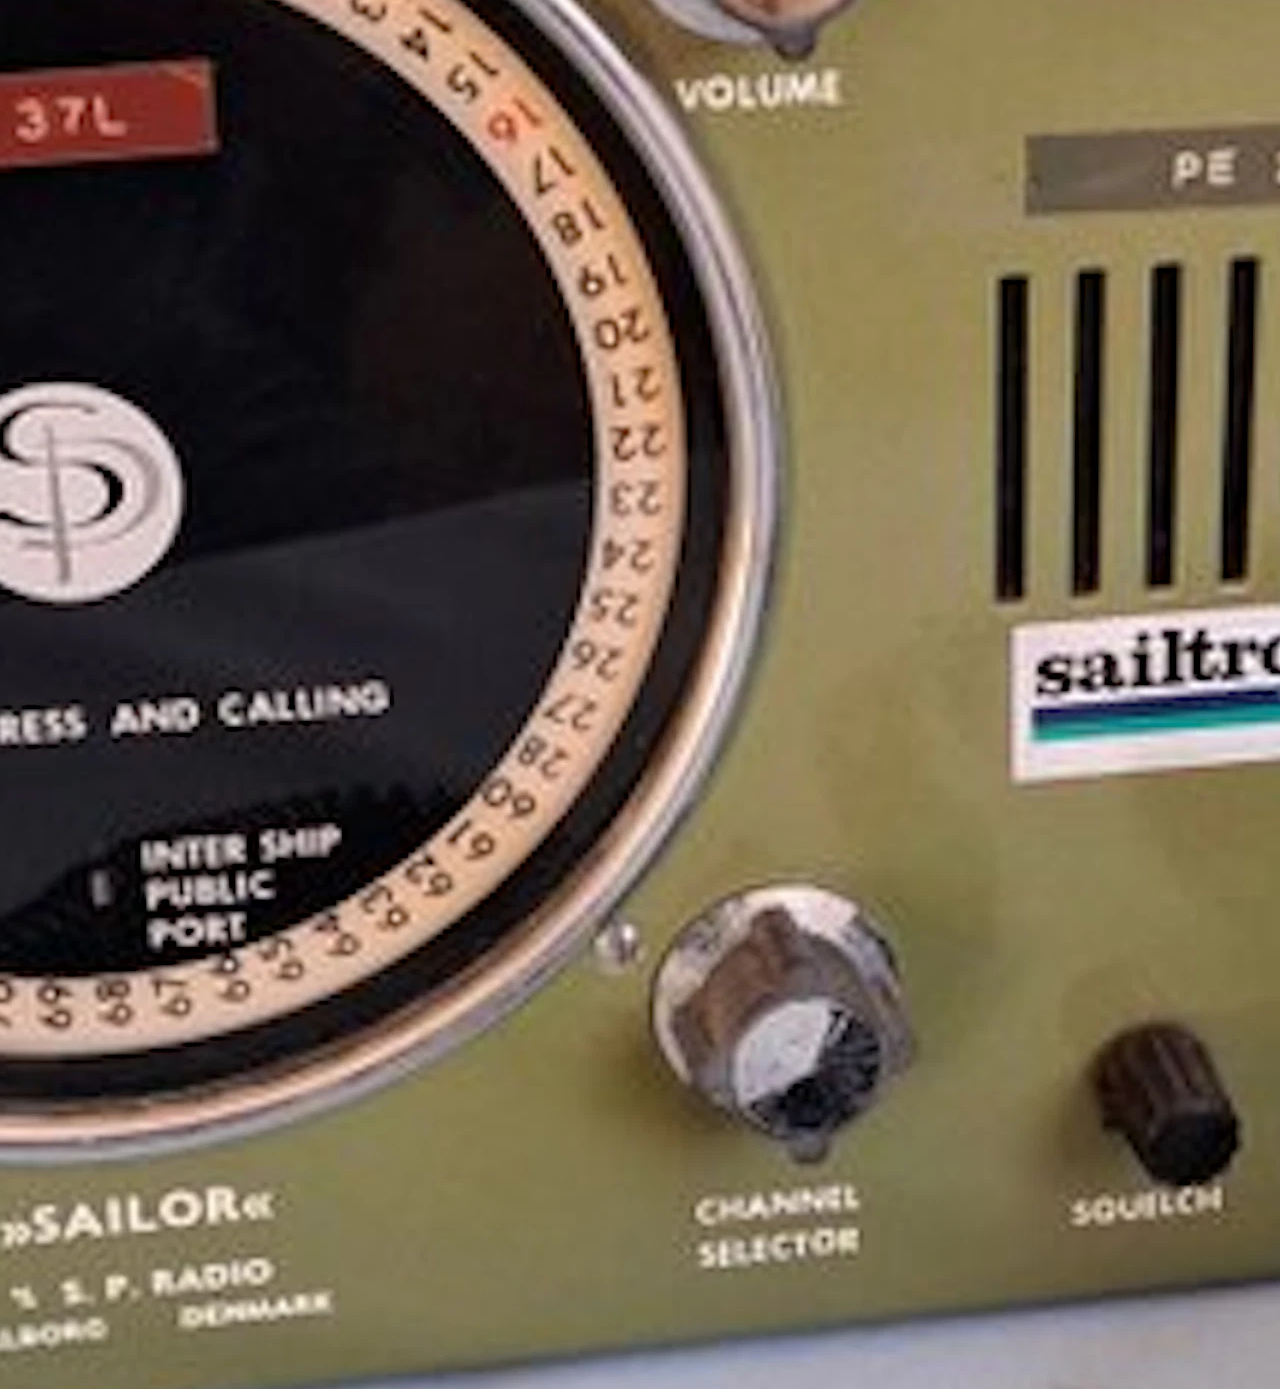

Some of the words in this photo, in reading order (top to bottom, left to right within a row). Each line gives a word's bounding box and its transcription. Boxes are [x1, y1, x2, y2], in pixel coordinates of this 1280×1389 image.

[399, 9, 453, 59] 14
[445, 51, 499, 103] 15
[675, 69, 841, 110] VOLUME
[15, 94, 126, 143] 37L
[488, 96, 544, 148] 16
[529, 146, 577, 195] 17
[1173, 149, 1235, 187] PE
[553, 197, 608, 243] 18
[577, 254, 628, 299] 19
[595, 310, 651, 349] 20
[611, 366, 663, 406] 21
[610, 424, 667, 461] 22
[609, 479, 664, 515] 23
[601, 537, 657, 574] 24
[590, 589, 640, 629] 25
[572, 639, 622, 683] 26
[110, 697, 201, 739] AND
[218, 679, 391, 728] CALLING
[546, 693, 597, 735] 27
[518, 735, 571, 780] 28
[481, 778, 538, 820] 60
[140, 833, 248, 873] INTER
[258, 821, 342, 864] SHIP
[445, 821, 497, 863] 61
[145, 867, 277, 911] PUBLIC
[404, 853, 458, 900] 62
[360, 884, 411, 933] 63
[145, 911, 248, 952] PORT
[257, 937, 306, 982] 65
[35, 980, 73, 1031] 69
[95, 977, 133, 1026] 68
[151, 978, 192, 1018] 67
[693, 1184, 861, 1227] CHANNEL
[1070, 1185, 1224, 1226] SQUELCH
[697, 1228, 861, 1270] SELECTOR
[151, 1257, 276, 1297] RADIO
[178, 1290, 335, 1329] DENMARK
